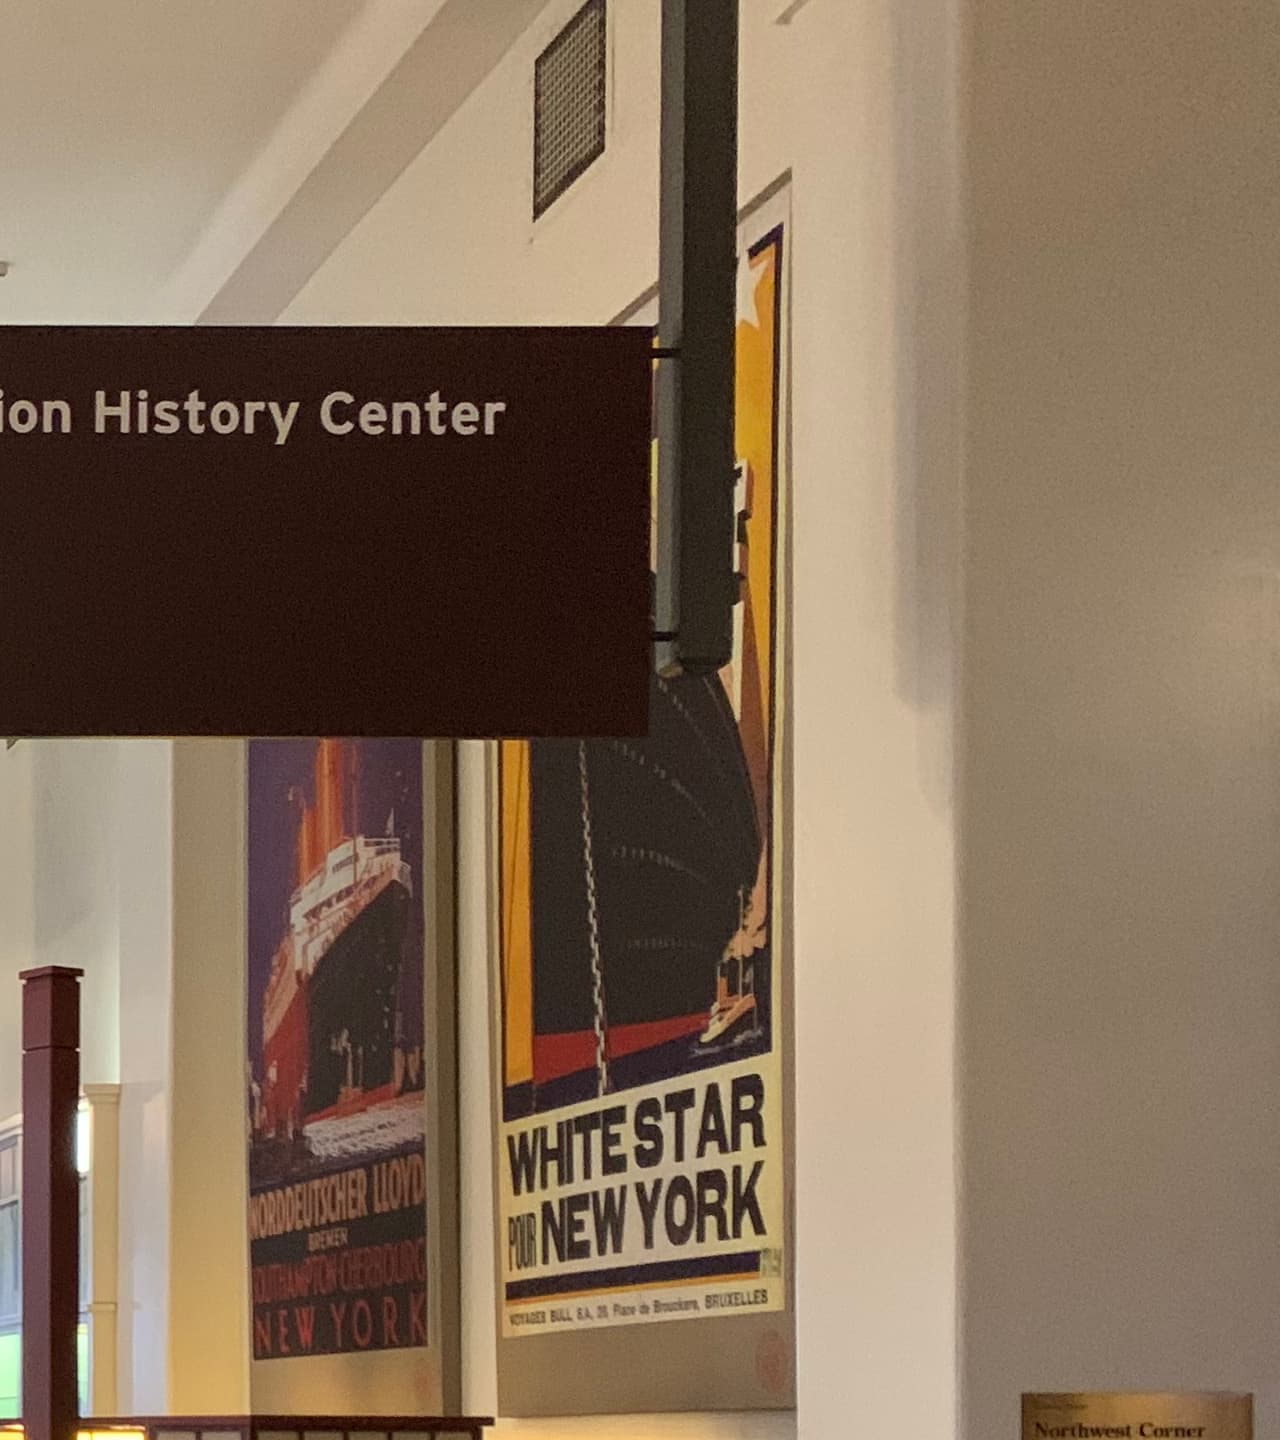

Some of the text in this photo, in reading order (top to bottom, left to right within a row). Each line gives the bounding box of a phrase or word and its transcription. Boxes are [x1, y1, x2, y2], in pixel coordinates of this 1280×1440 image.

[95, 389, 300, 445] History
[321, 391, 506, 436] Center
[508, 1073, 767, 1196] WHITE STAR
[374, 1153, 425, 1213] LLOYD
[508, 1160, 767, 1272] POUR NEW YORK
[255, 1292, 427, 1354] NEW YORK
[705, 1289, 768, 1309] BRUXELLES
[1034, 1422, 1206, 1439] Northwest Corner
